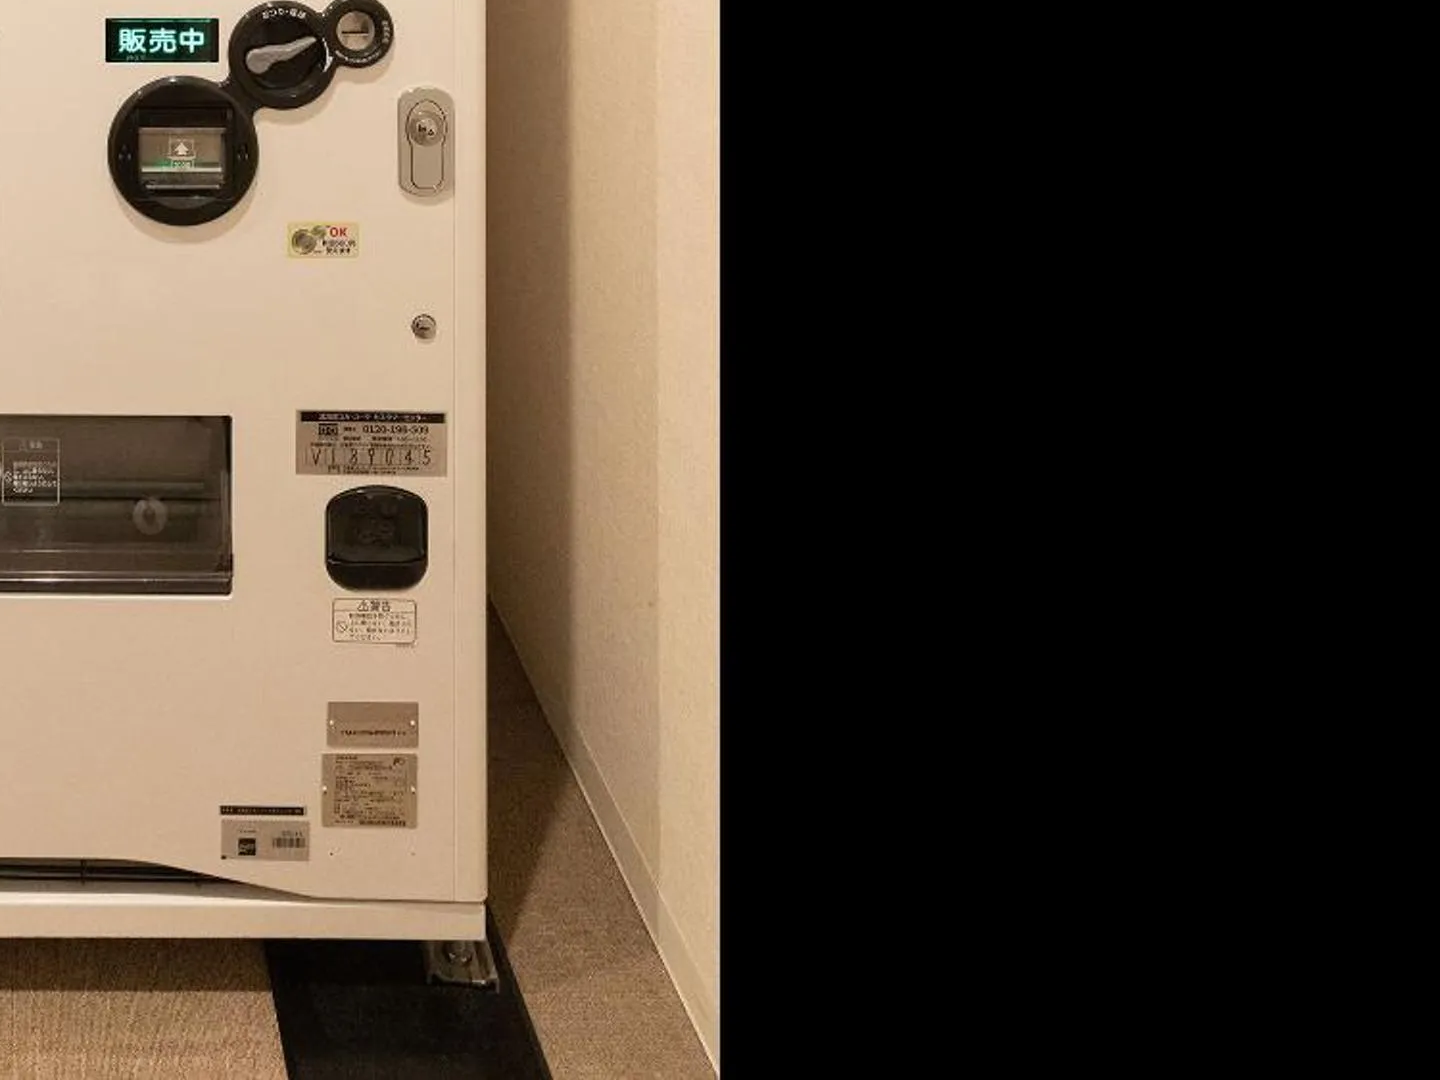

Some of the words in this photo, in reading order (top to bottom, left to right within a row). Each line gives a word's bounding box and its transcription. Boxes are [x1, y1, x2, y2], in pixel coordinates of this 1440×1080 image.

[118, 28, 205, 54] 販売中
[329, 227, 348, 238] OK
